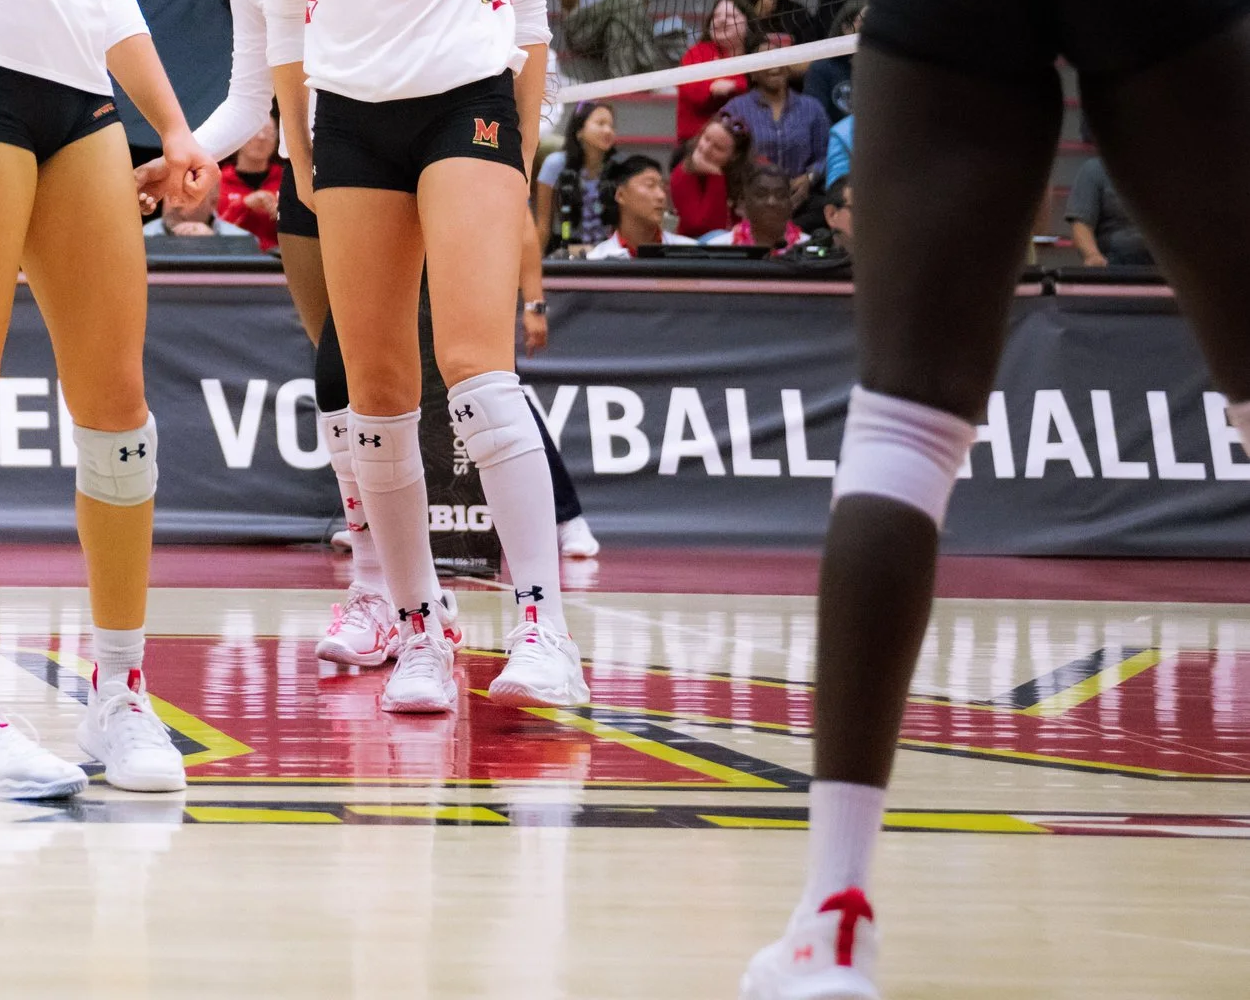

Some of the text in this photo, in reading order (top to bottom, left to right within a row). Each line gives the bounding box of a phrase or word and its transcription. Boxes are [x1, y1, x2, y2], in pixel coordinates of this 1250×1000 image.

[472, 117, 500, 146] M
[200, 378, 837, 477] VOYBALL
[955, 388, 1250, 481] HALLE
